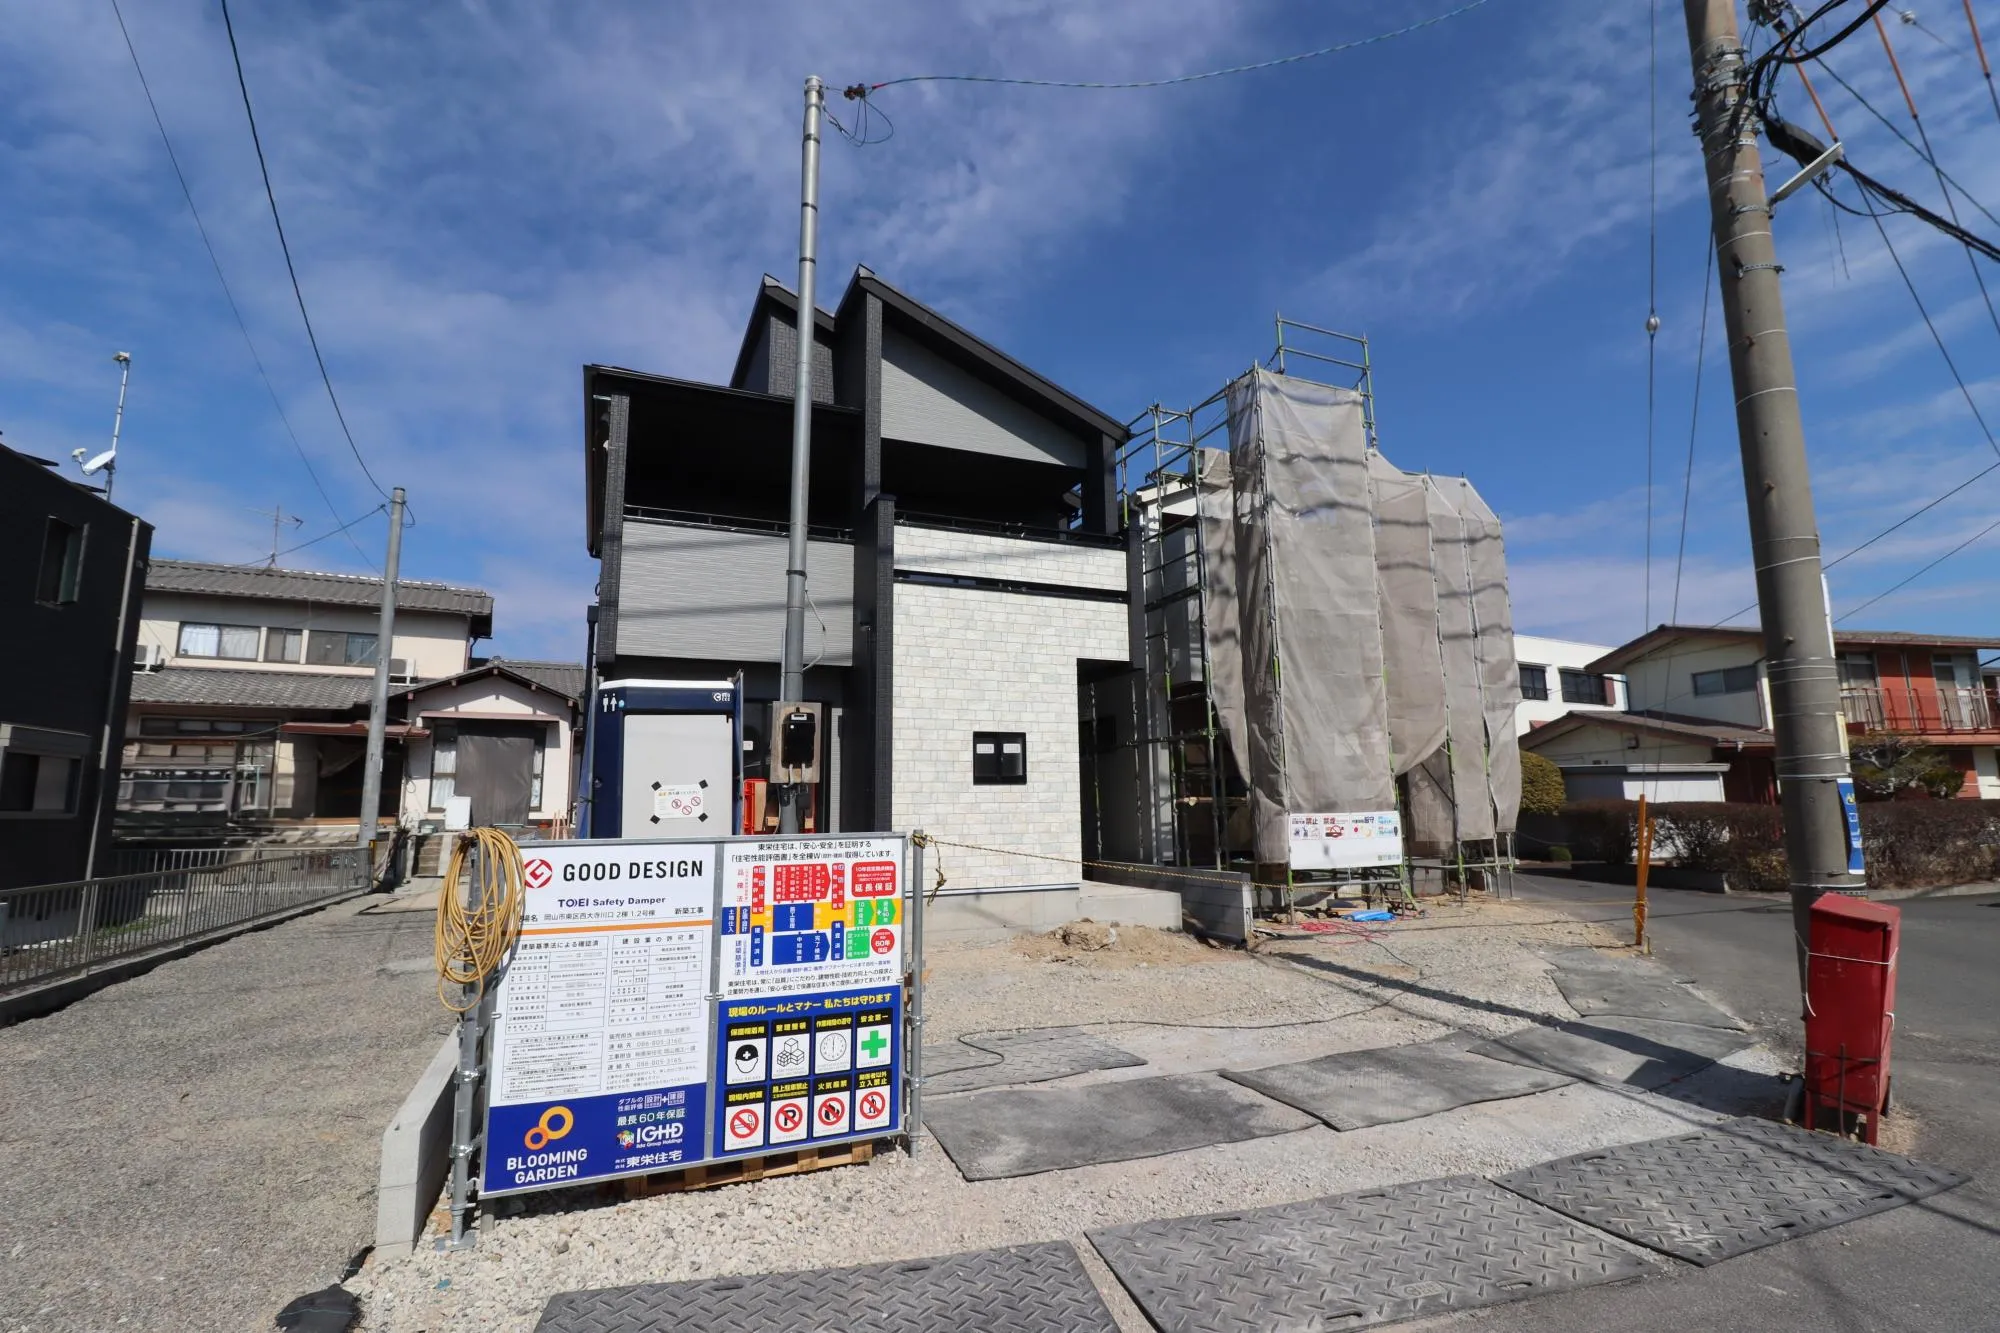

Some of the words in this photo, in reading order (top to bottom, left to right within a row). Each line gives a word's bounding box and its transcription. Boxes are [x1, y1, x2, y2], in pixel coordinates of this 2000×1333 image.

[563, 863, 621, 882] GOOD
[628, 860, 703, 880] DESIGN
[592, 898, 624, 907] Safety
[628, 896, 666, 905] Damper
[674, 906, 704, 915] 新築工事
[728, 1001, 821, 1018] 現場のルールとマナー
[824, 993, 892, 1009] 私たちは守ります
[860, 1014, 889, 1023] 安全第一
[859, 1078, 888, 1088] 立入禁止
[636, 1122, 684, 1144] IGHD
[506, 1148, 588, 1171] BLOOMING
[626, 1150, 683, 1168] 東栄住宅
[514, 1163, 578, 1184] GARDEN
